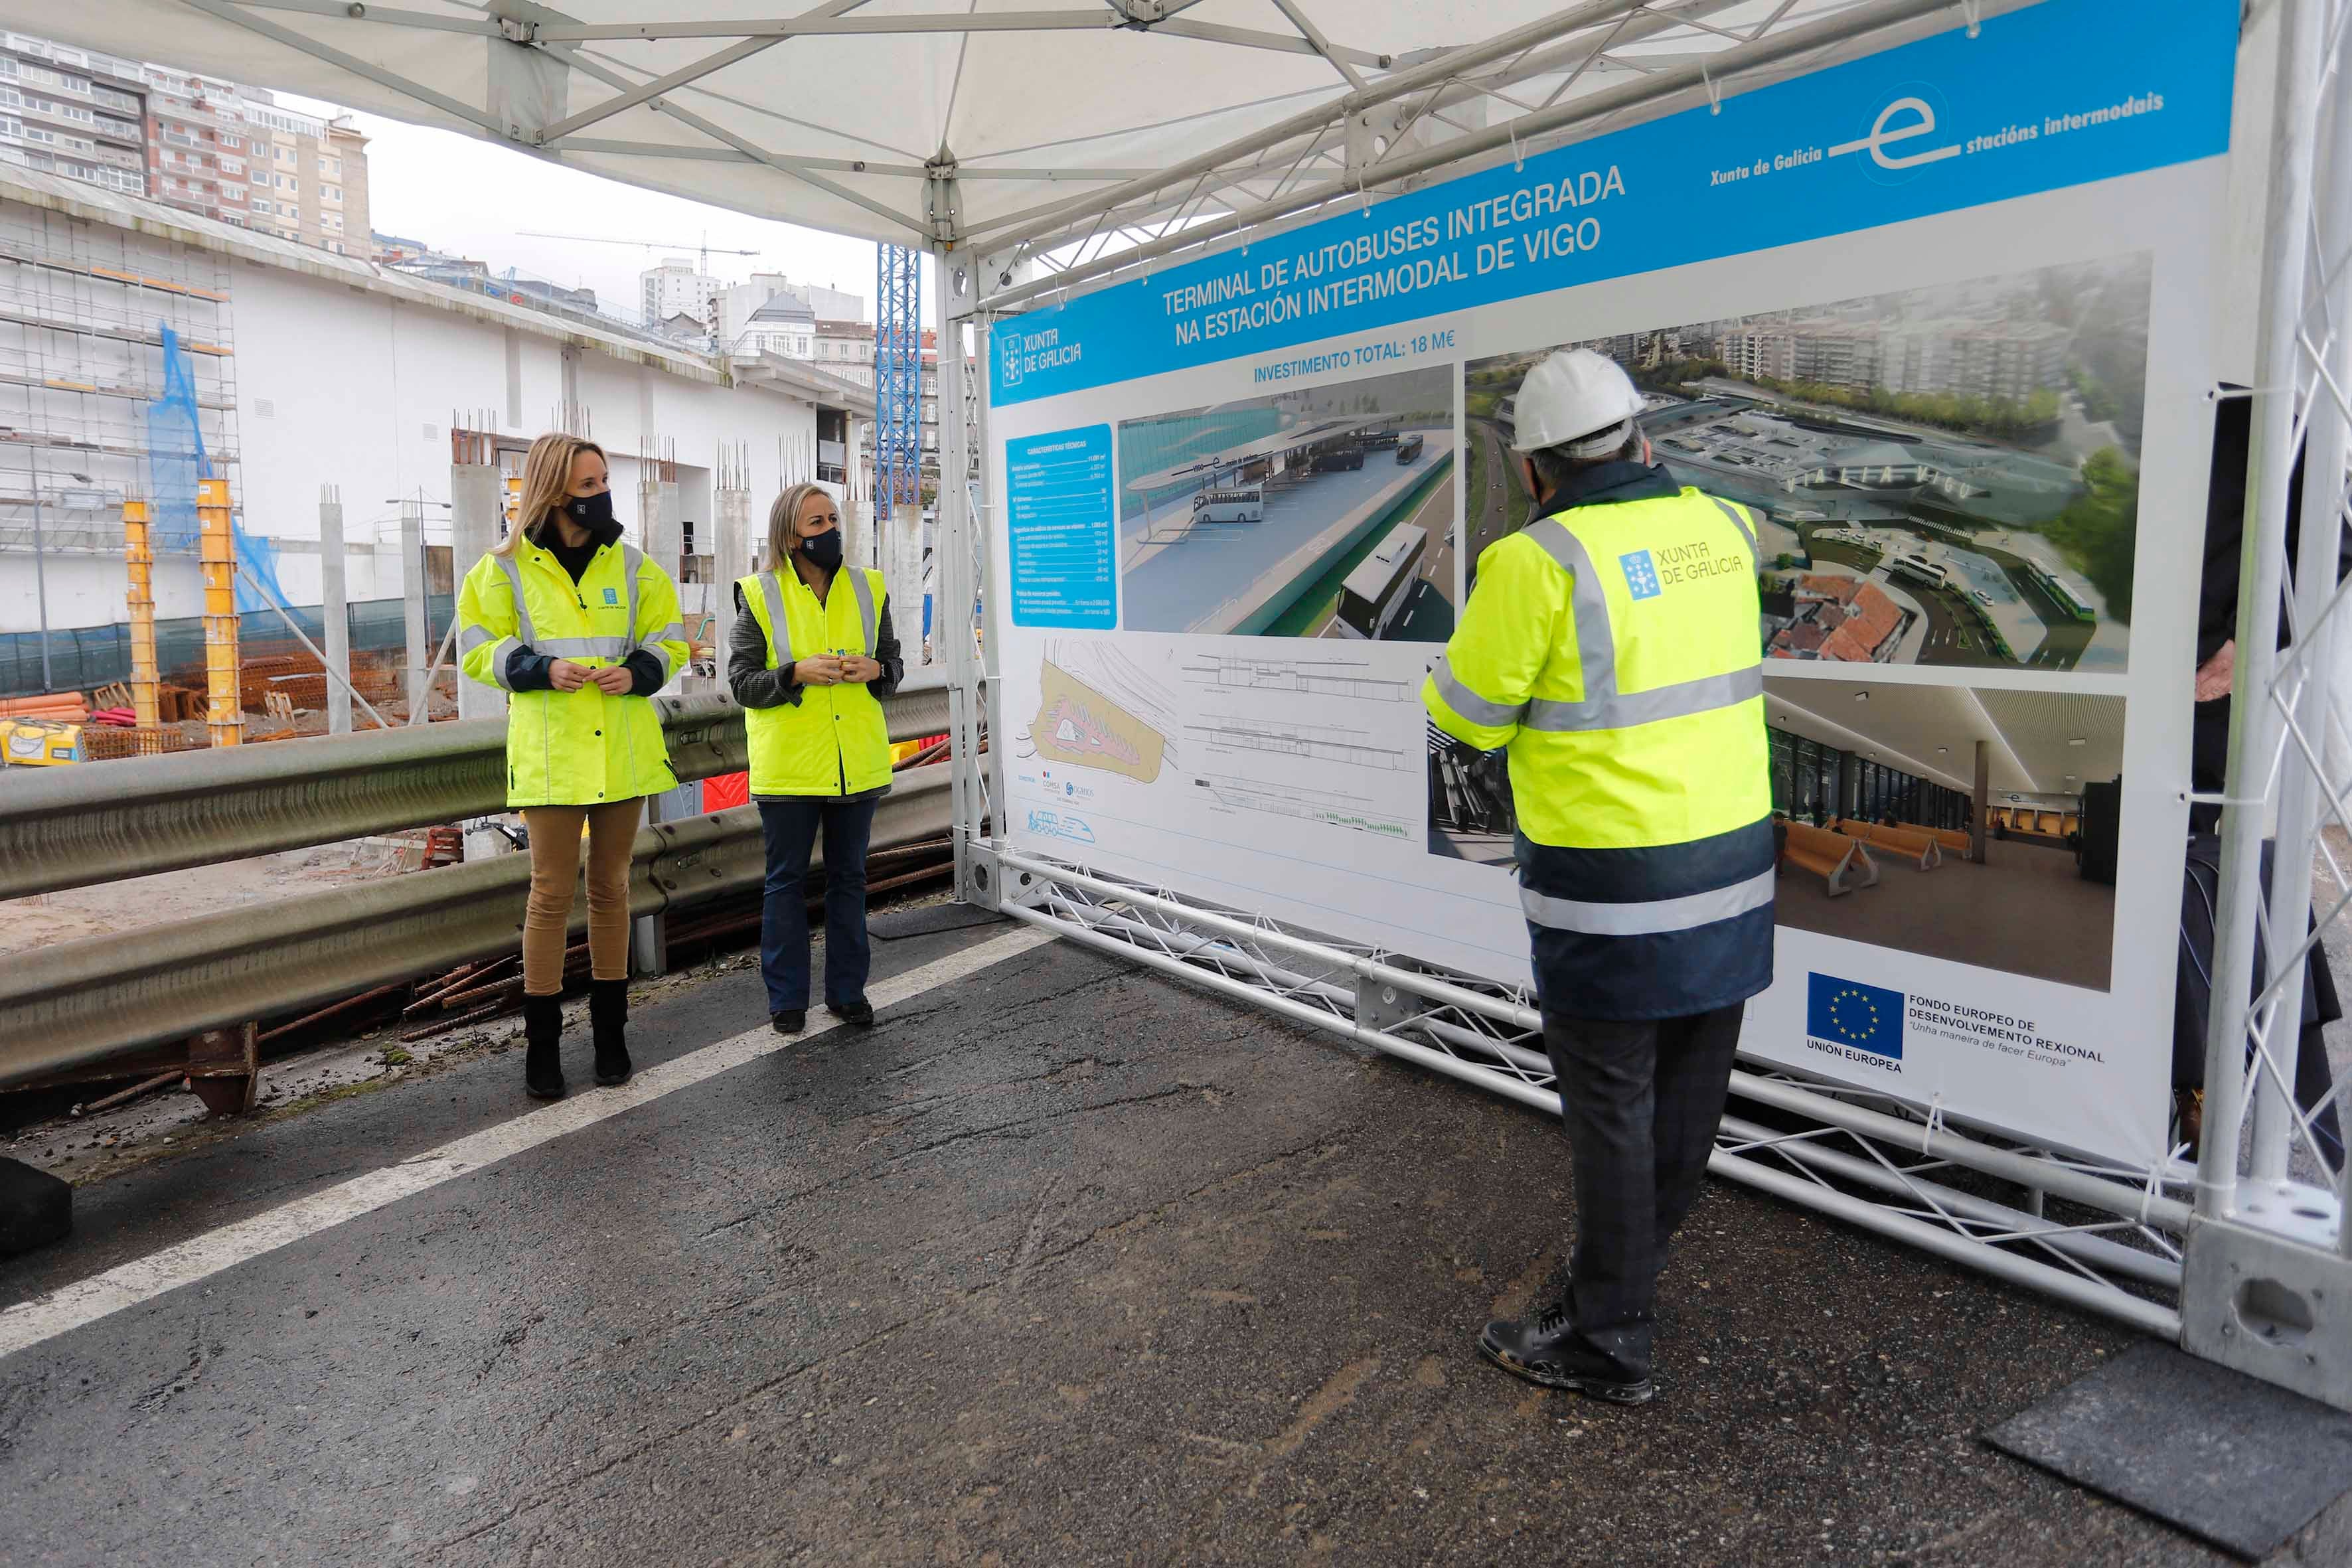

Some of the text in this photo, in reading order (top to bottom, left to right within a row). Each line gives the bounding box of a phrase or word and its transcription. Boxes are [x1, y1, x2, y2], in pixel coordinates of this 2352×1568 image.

[1710, 167, 1749, 187] Xunta
[1753, 159, 1770, 176] de
[1774, 146, 1822, 171] Galicia
[2043, 90, 2164, 136] intermodais
[1162, 165, 1626, 316] TERMINAL DE AUTOBUSES INTEGRADA
[1175, 216, 1601, 347] NA ESTACIÓN INTERMODAL DE VIGO
[1023, 328, 1058, 353] XUNTA
[1254, 329, 1455, 383] INVESTIMENTO TOTAL: 18 M€
[1024, 343, 1081, 373] DE GALICIA
[1786, 466, 1893, 494] VIALIA
[1657, 542, 1711, 566] XUNTA
[1662, 556, 1744, 585] DE GALICIA
[1909, 994, 2035, 1032] FONDO EUROPEO DE
[1909, 1008, 2106, 1063] DESENVOLVEMENTO REXIONAL
[1939, 1030, 1980, 1046] maneira
[1982, 1040, 1996, 1050] de
[1997, 1042, 2024, 1057] facer
[1806, 1039, 1902, 1073] UNIÓN EUROPEA
